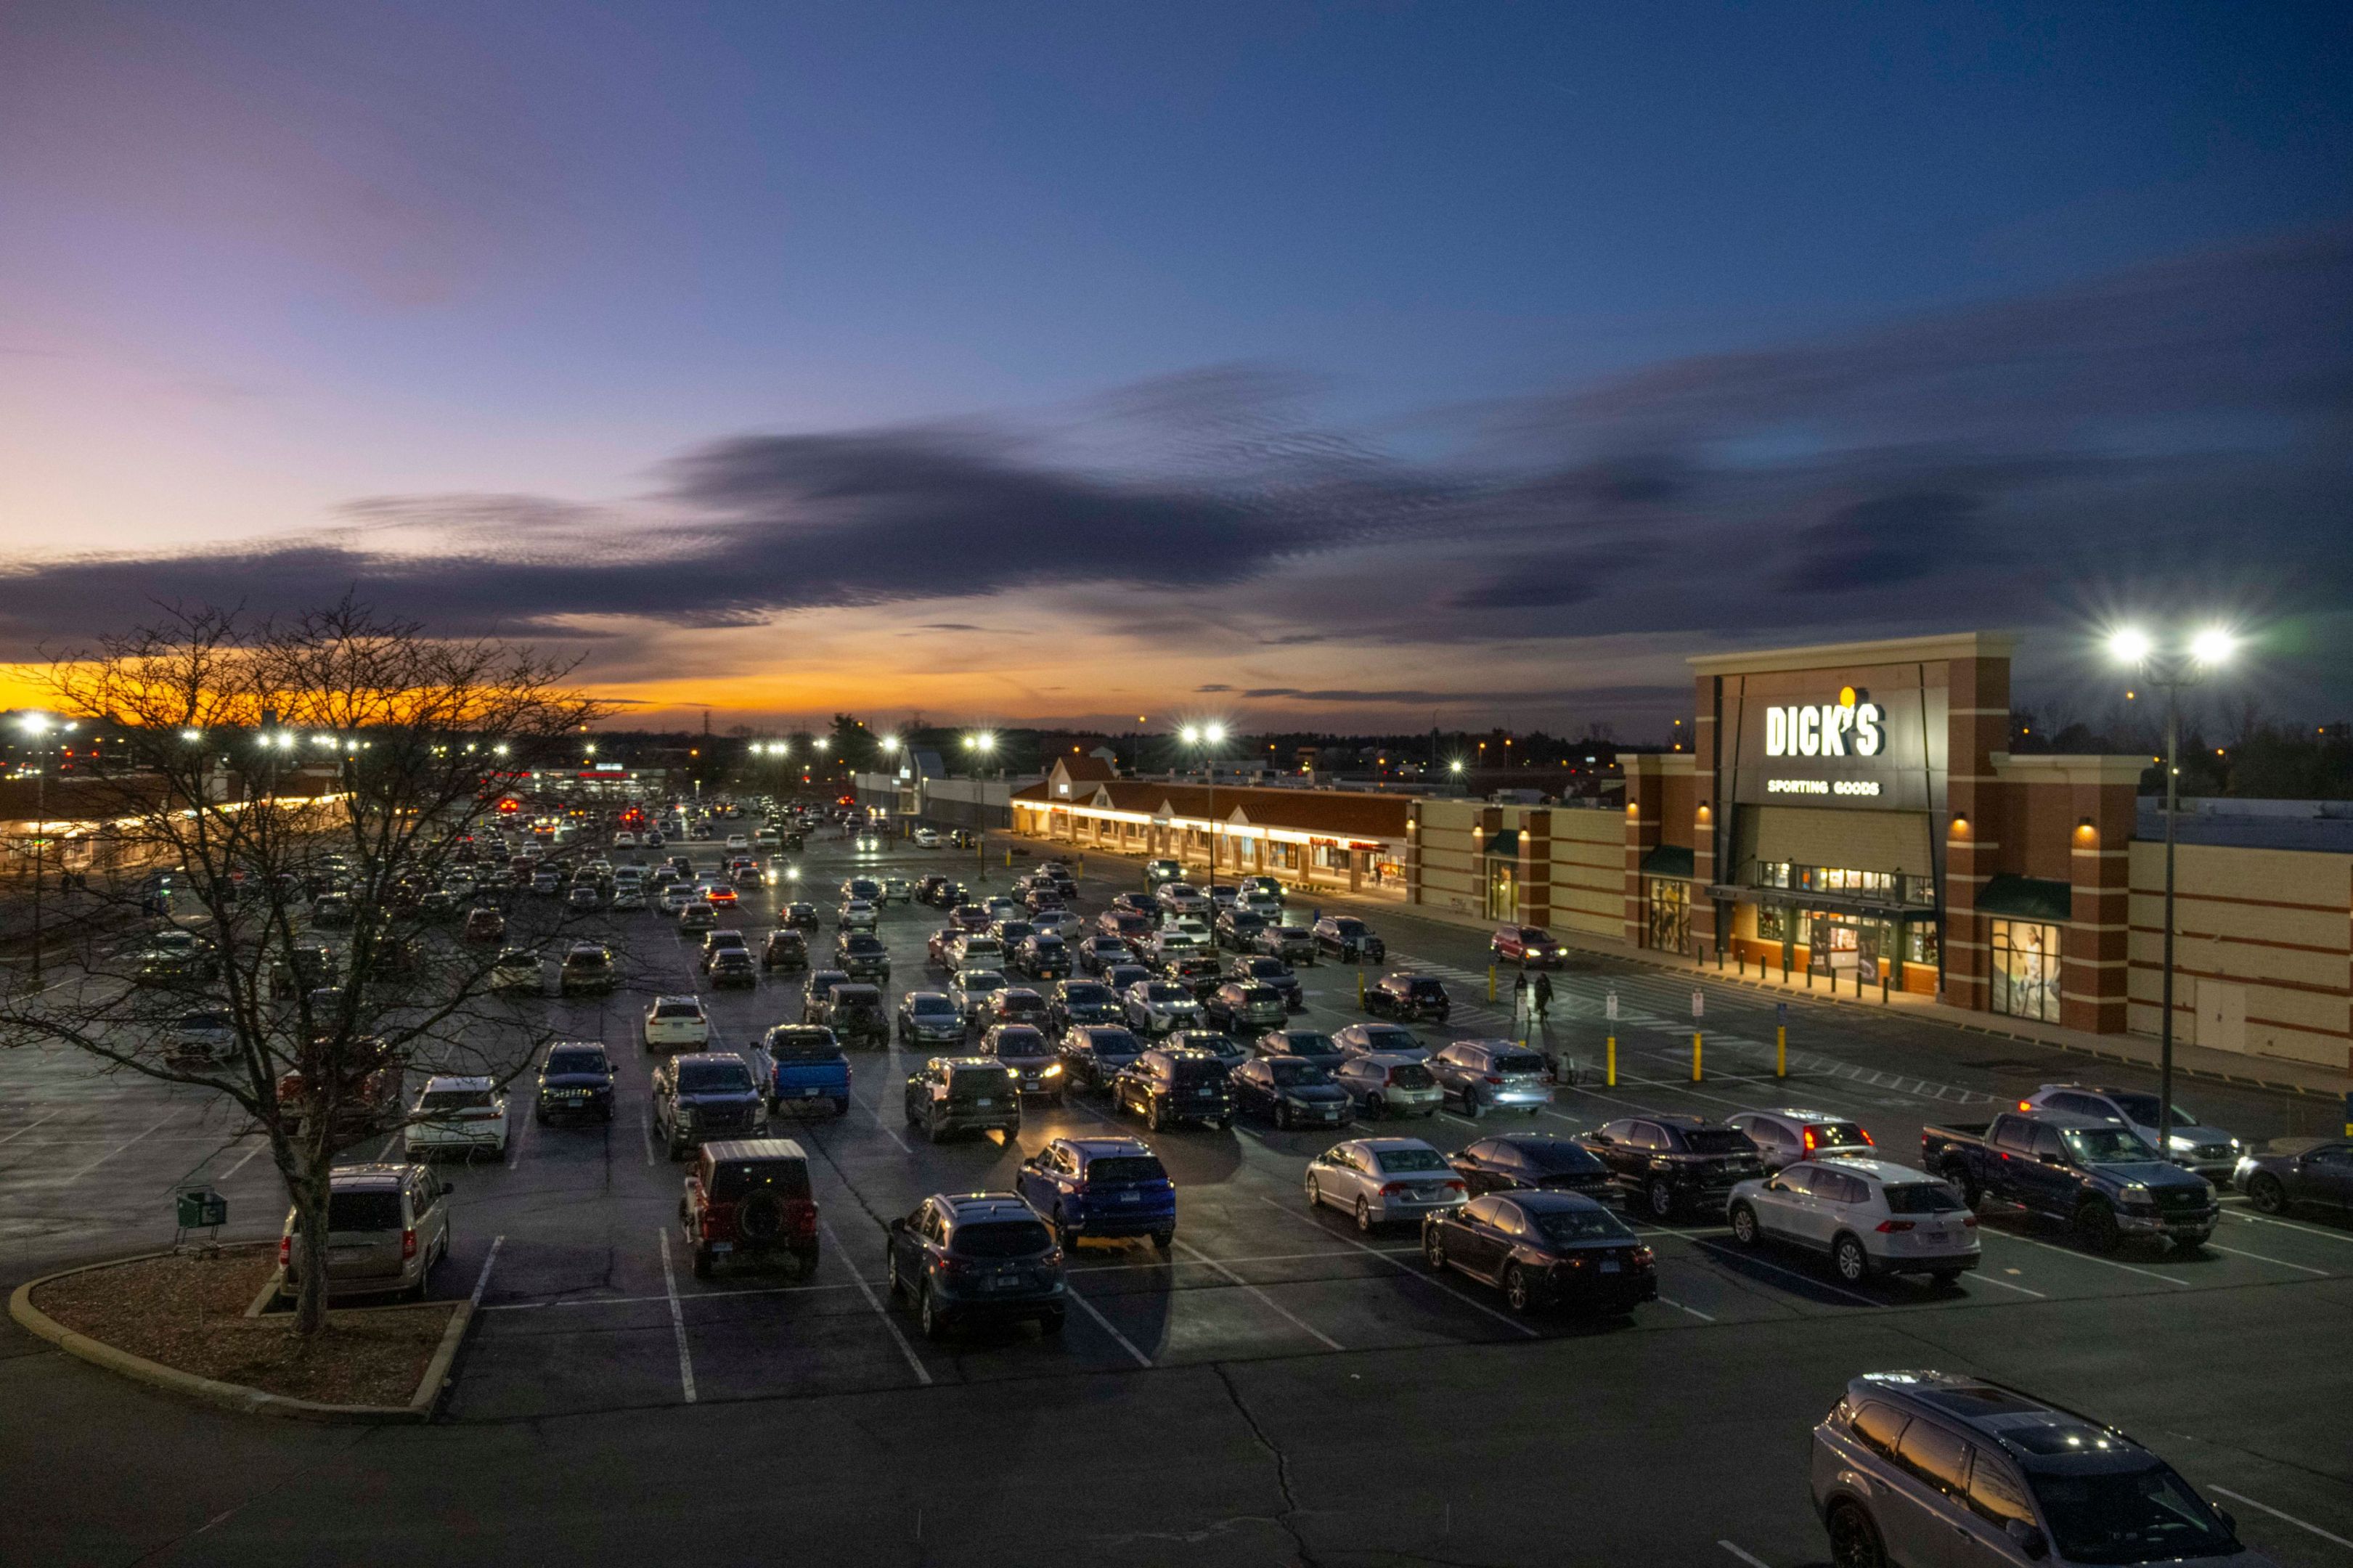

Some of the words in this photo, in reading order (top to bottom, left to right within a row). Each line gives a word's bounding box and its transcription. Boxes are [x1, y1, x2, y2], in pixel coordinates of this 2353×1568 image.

[1766, 703, 1879, 756] DICK'S
[1767, 779, 1829, 794] SPORTING
[1833, 780, 1880, 796] GOODS
